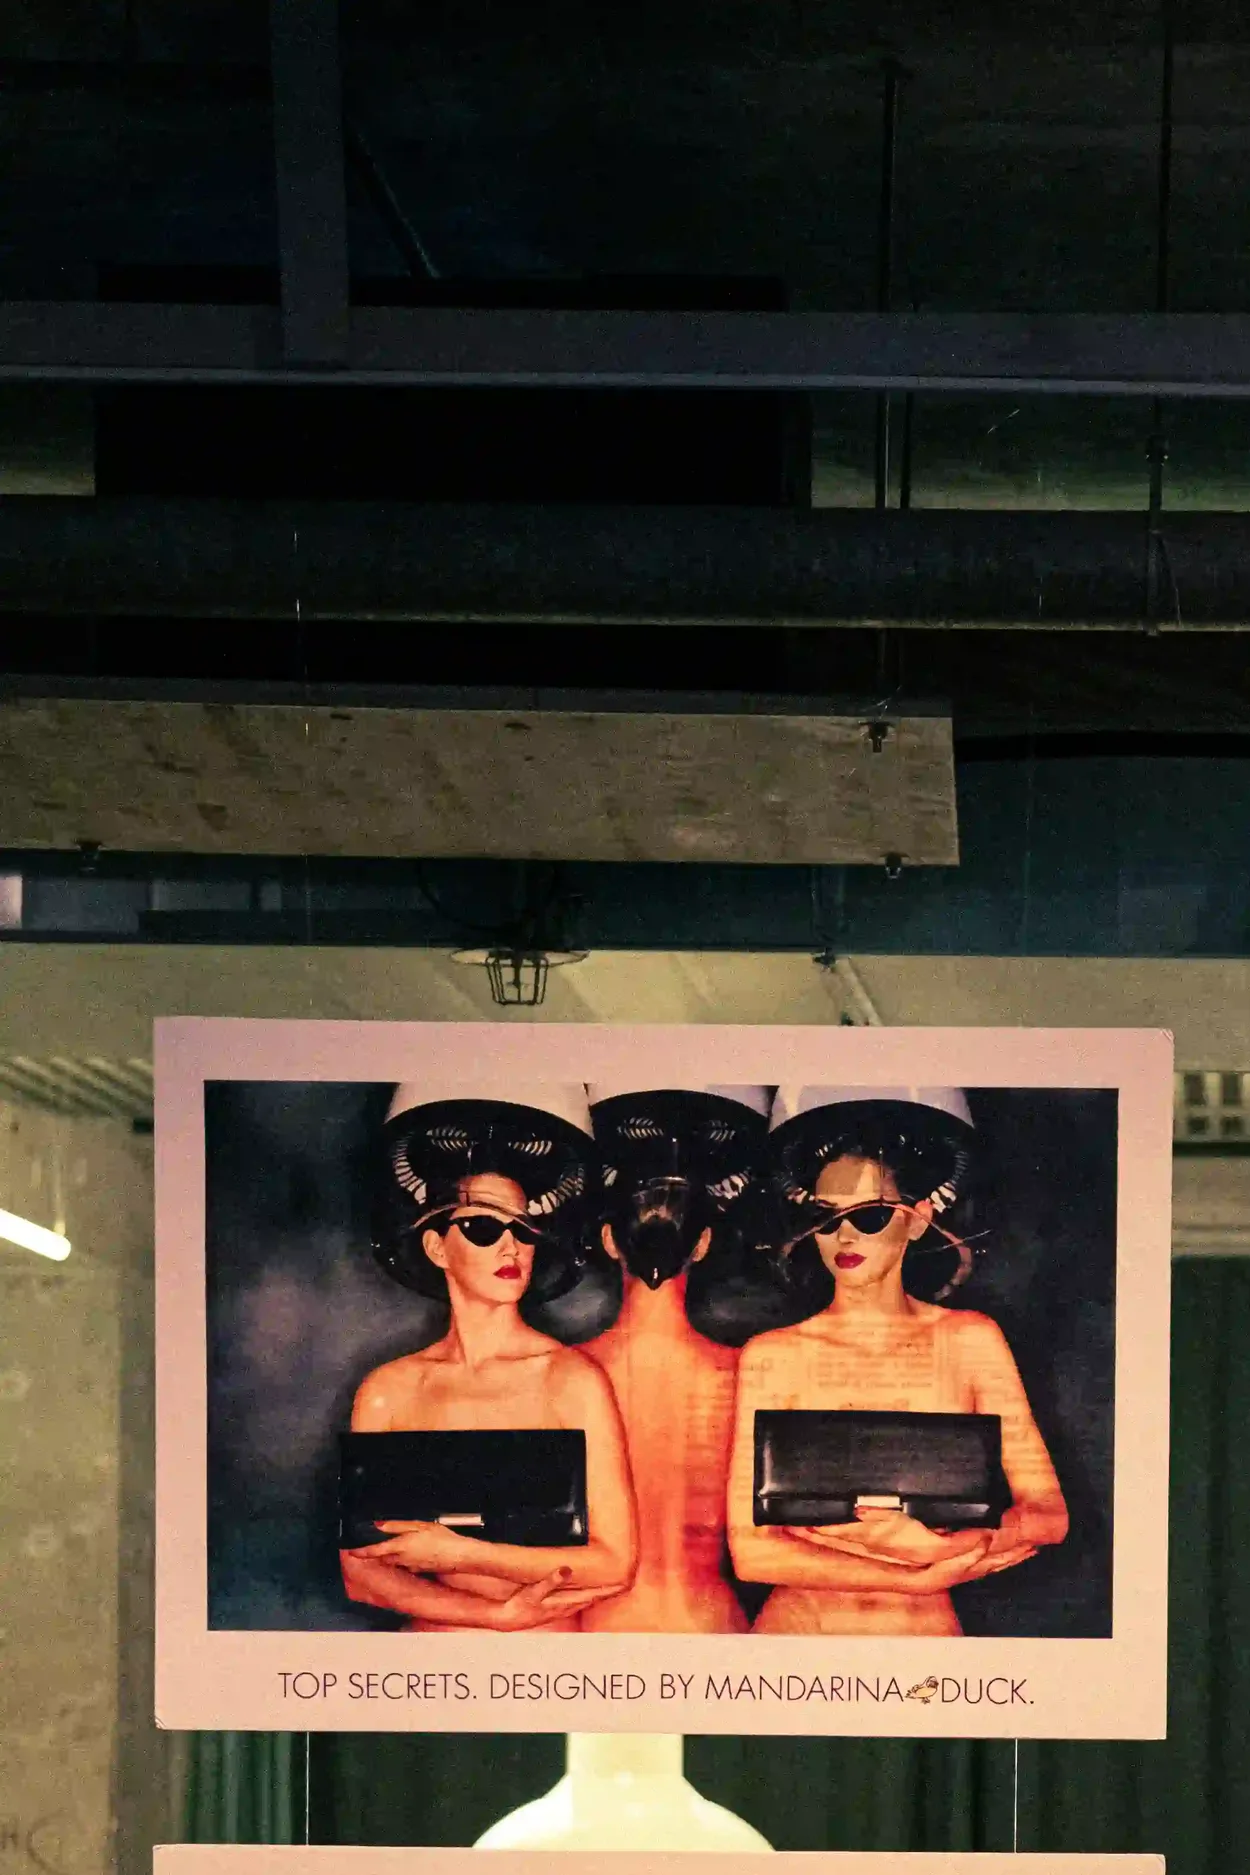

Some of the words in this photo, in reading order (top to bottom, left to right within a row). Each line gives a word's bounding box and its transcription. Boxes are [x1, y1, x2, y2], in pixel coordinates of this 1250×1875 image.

[277, 1671, 338, 1699] TOP
[347, 1672, 477, 1700] SECRETS.
[489, 1672, 646, 1700] DESIGNED
[660, 1673, 695, 1700] BY
[703, 1674, 905, 1702] MANDARINA
[940, 1677, 1035, 1705] DUCK.
